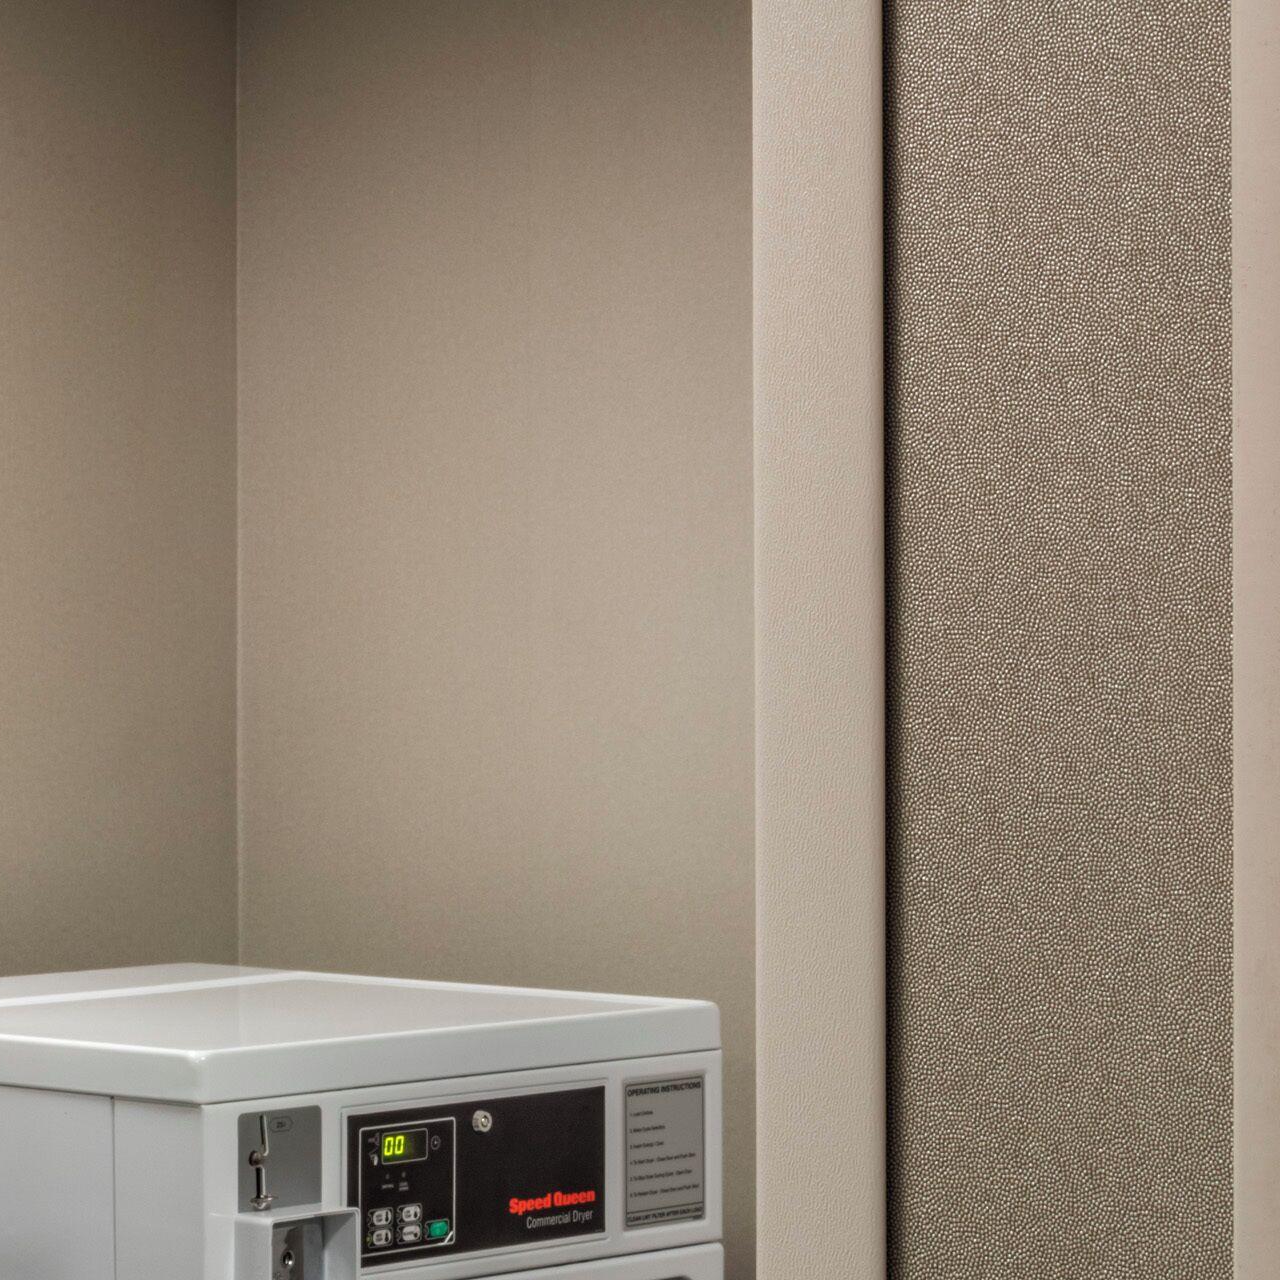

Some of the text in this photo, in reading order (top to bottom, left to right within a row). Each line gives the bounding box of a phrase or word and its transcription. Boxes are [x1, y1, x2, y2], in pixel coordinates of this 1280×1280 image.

[627, 1081, 701, 1097] OPERATING INSTRUCTIONS
[384, 1135, 405, 1156] 00
[509, 1190, 595, 1216] Speed Queen
[526, 1210, 593, 1229] Commercial Dryer
